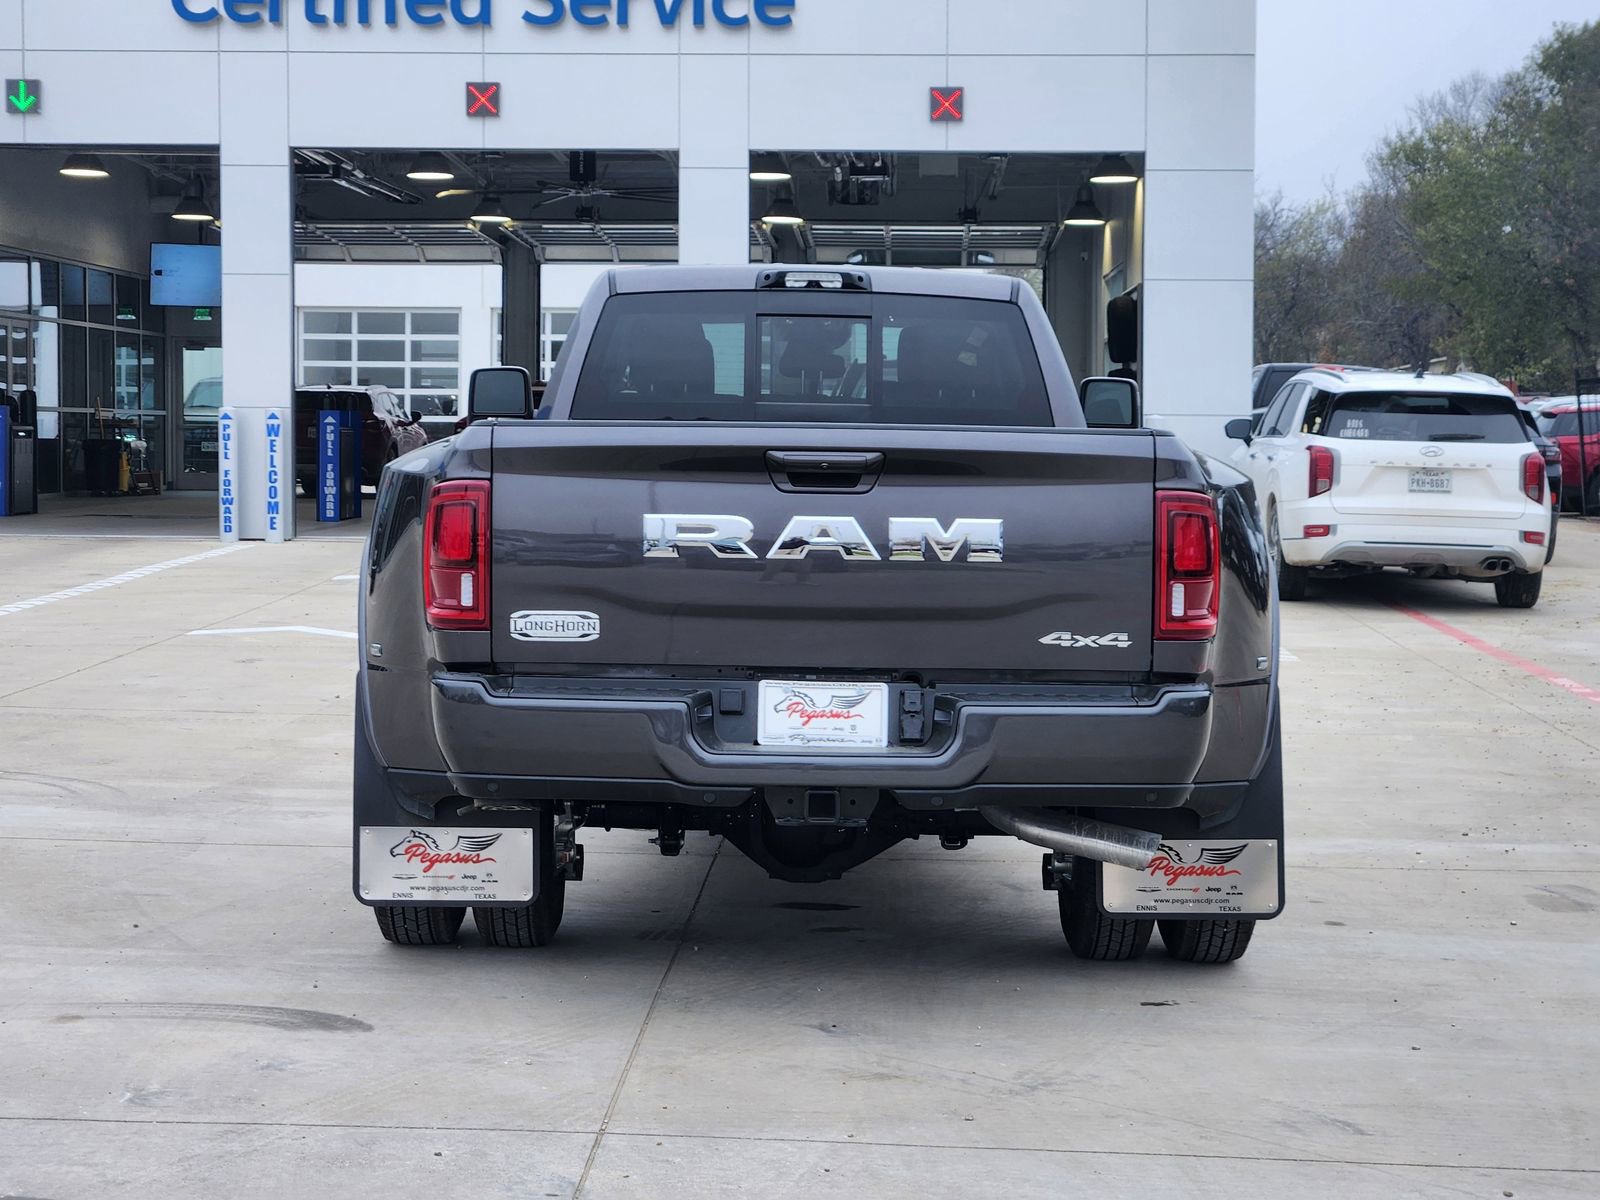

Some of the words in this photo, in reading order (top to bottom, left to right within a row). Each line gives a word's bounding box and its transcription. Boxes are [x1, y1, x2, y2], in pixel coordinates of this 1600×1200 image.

[222, 423, 231, 460] PULL
[326, 425, 334, 456] PULL
[266, 423, 280, 530] WELCOME
[323, 463, 336, 517] FORWARD
[220, 469, 234, 533] FORWARD
[642, 512, 1005, 563] RAM
[1037, 631, 1133, 648] 4x4
[786, 701, 864, 727] Pegasus
[403, 843, 496, 873] Pegasus
[1147, 856, 1242, 886] Pegasus
[1153, 896, 1230, 905] www.pegasuscdjr.com
